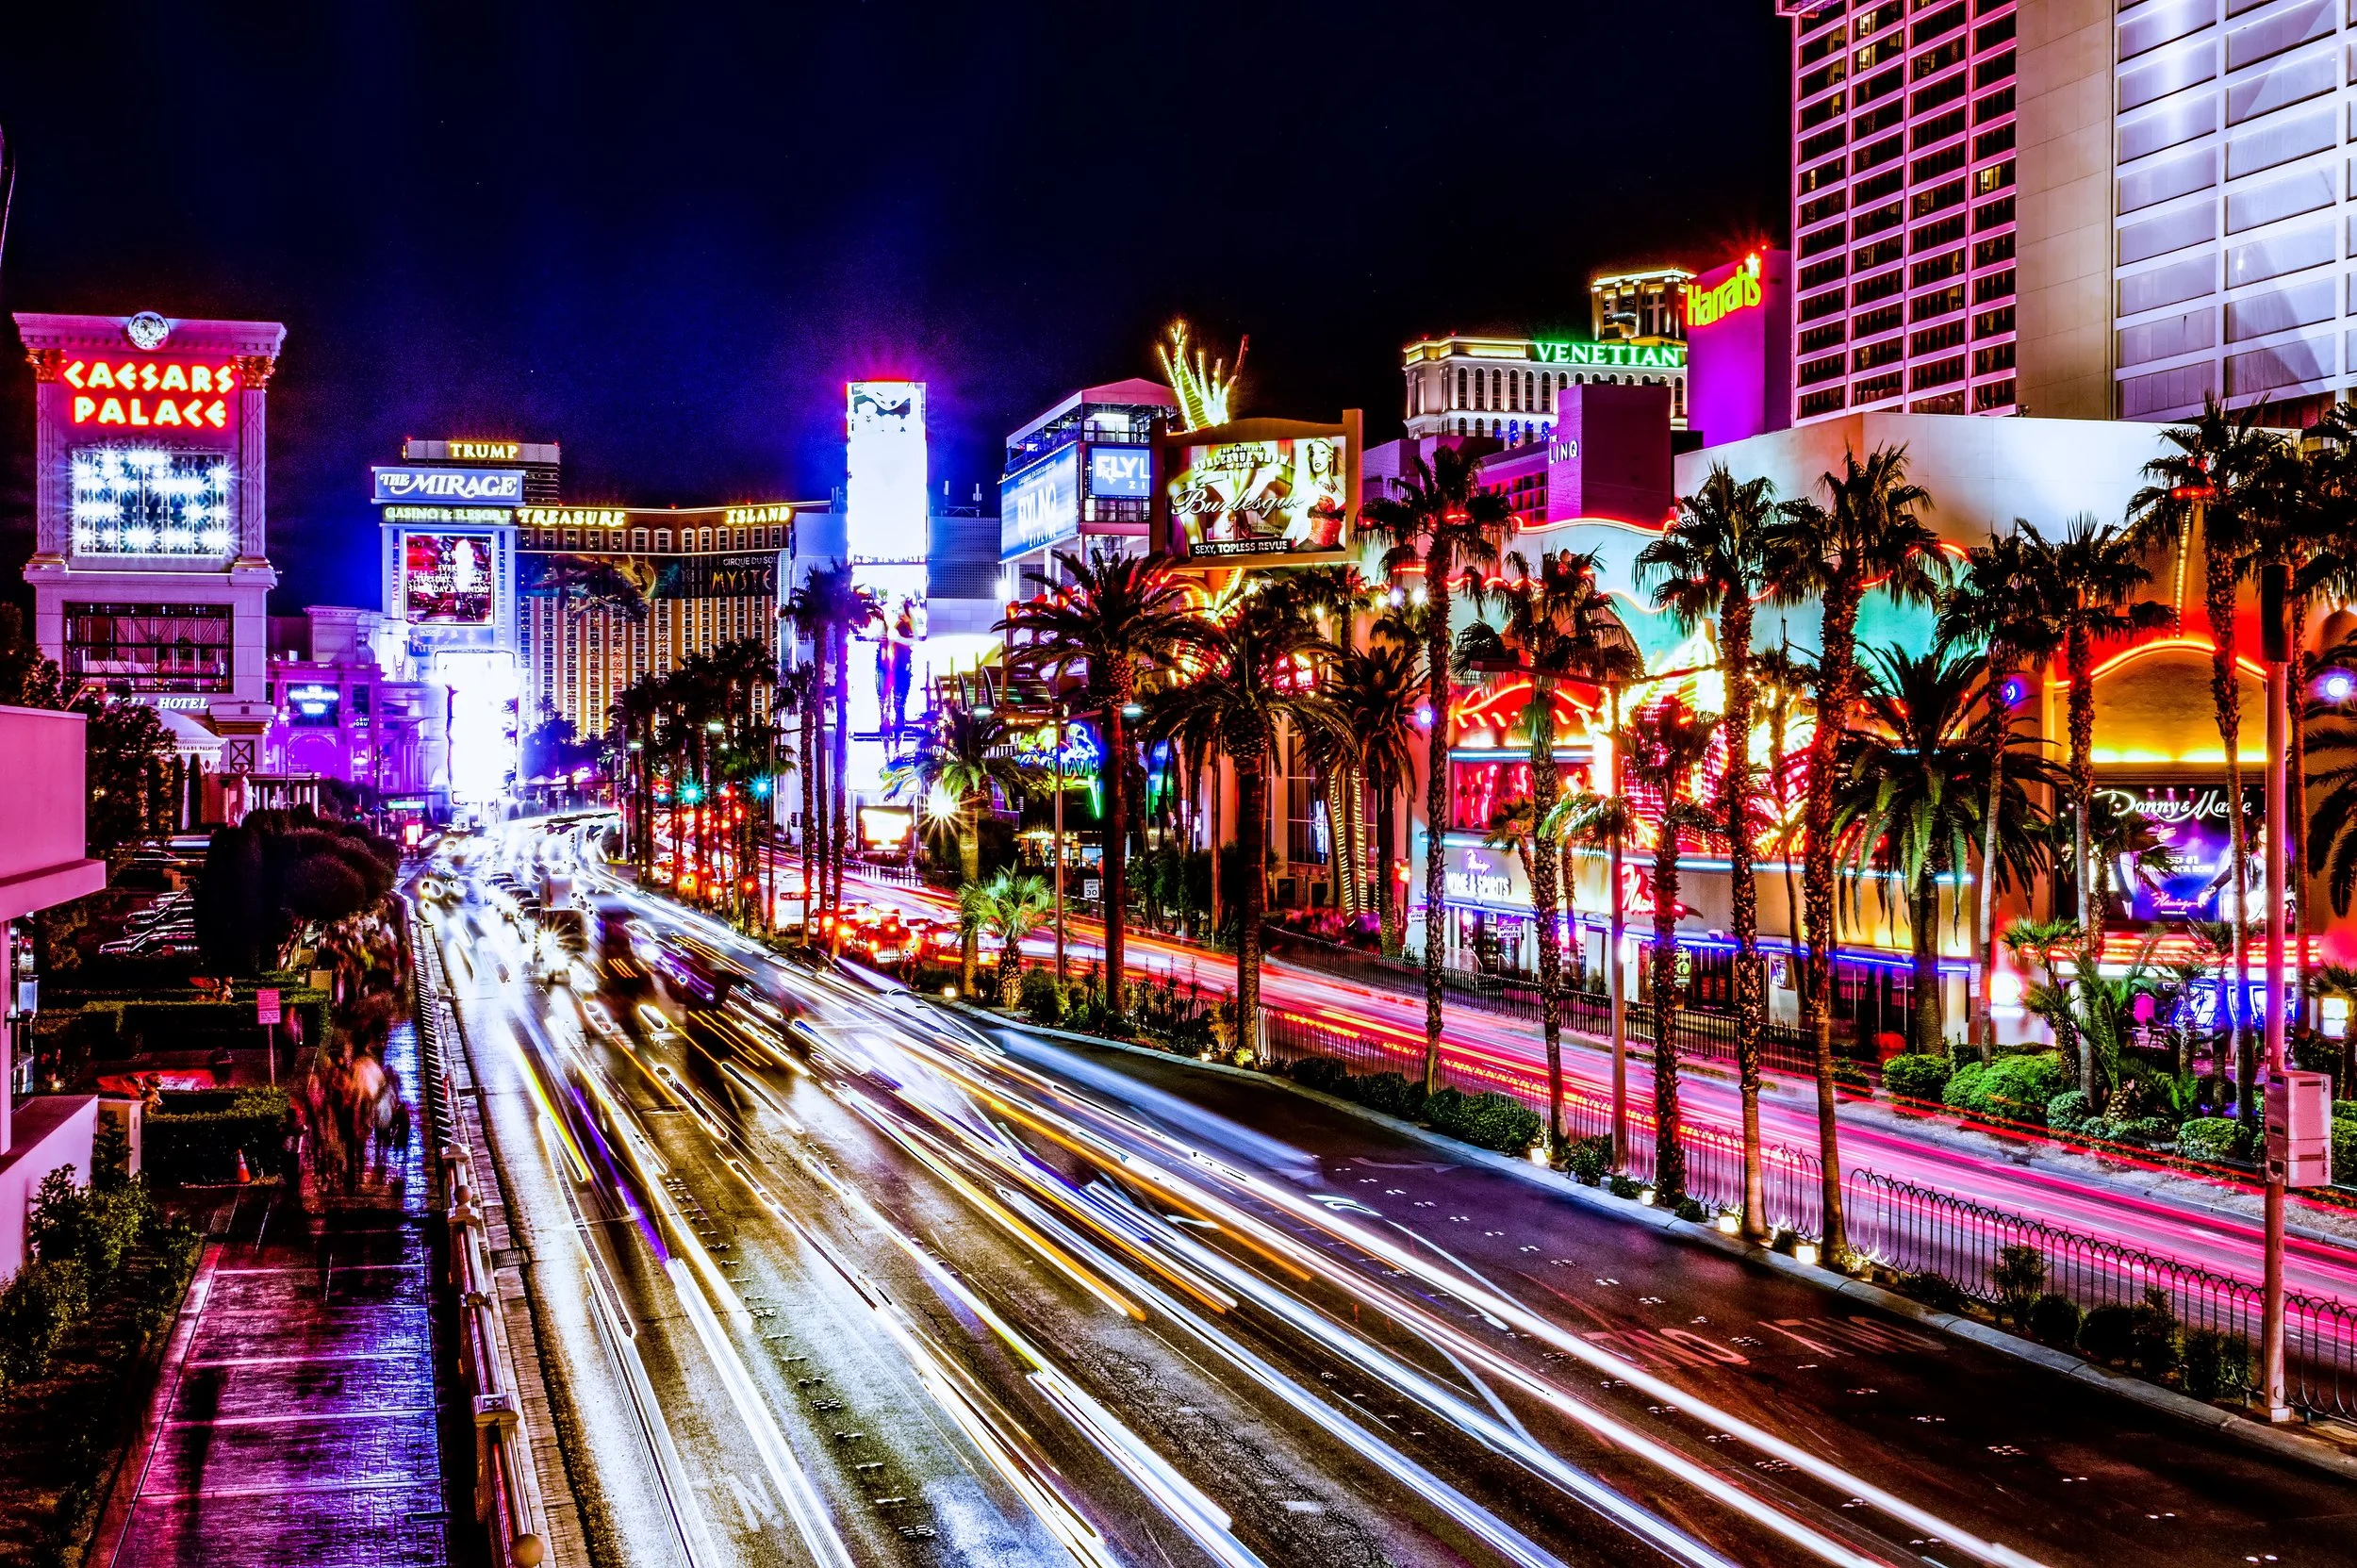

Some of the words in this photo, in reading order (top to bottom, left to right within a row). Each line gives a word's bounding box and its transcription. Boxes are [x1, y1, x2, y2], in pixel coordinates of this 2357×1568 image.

[1535, 342, 1681, 368] VENETIAN
[63, 360, 235, 394] CAESARS
[74, 396, 226, 428] PALACE
[450, 443, 519, 459] TRUMP
[1193, 452, 1253, 472] BURLESQUE
[1549, 440, 1578, 464] LINQ
[379, 473, 410, 487] THE
[390, 474, 518, 498] MIRAGE
[385, 507, 439, 520] CASINO
[454, 508, 513, 521] RESORT
[1171, 489, 1307, 520] Burlesque
[517, 509, 626, 527] TREASURE
[726, 506, 790, 523] ISLAND
[1195, 545, 1217, 554] SEXY,
[1217, 542, 1256, 553] TOPLESS
[1258, 540, 1288, 551] REVUE
[723, 556, 750, 568] CIRQUE
[157, 698, 209, 709] HOTEL
[1445, 871, 1469, 892] WINE
[1476, 874, 1510, 898] SPIRITS
[1580, 1328, 1750, 1372] ONL
